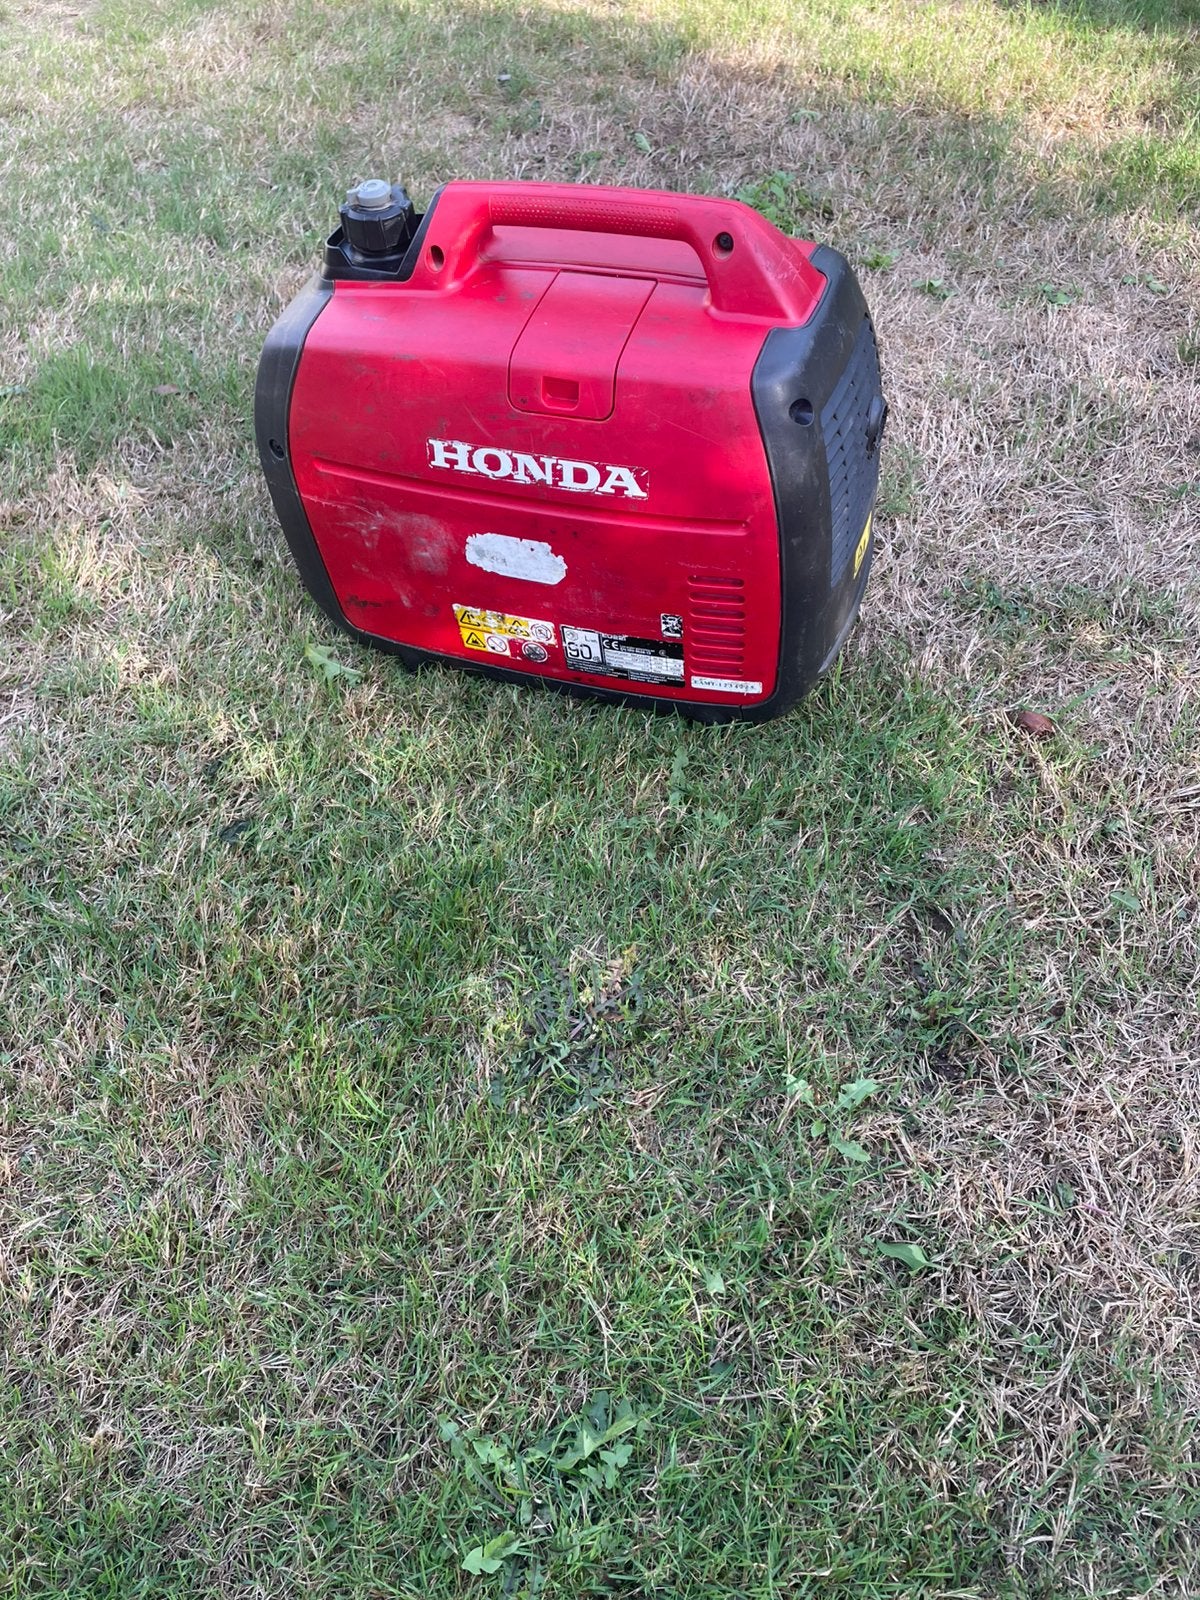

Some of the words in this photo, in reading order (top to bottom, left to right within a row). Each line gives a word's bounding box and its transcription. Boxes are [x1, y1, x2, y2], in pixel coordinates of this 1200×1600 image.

[428, 439, 648, 498] HONDA
[567, 641, 592, 660] 90
[603, 639, 620, 650] CE
